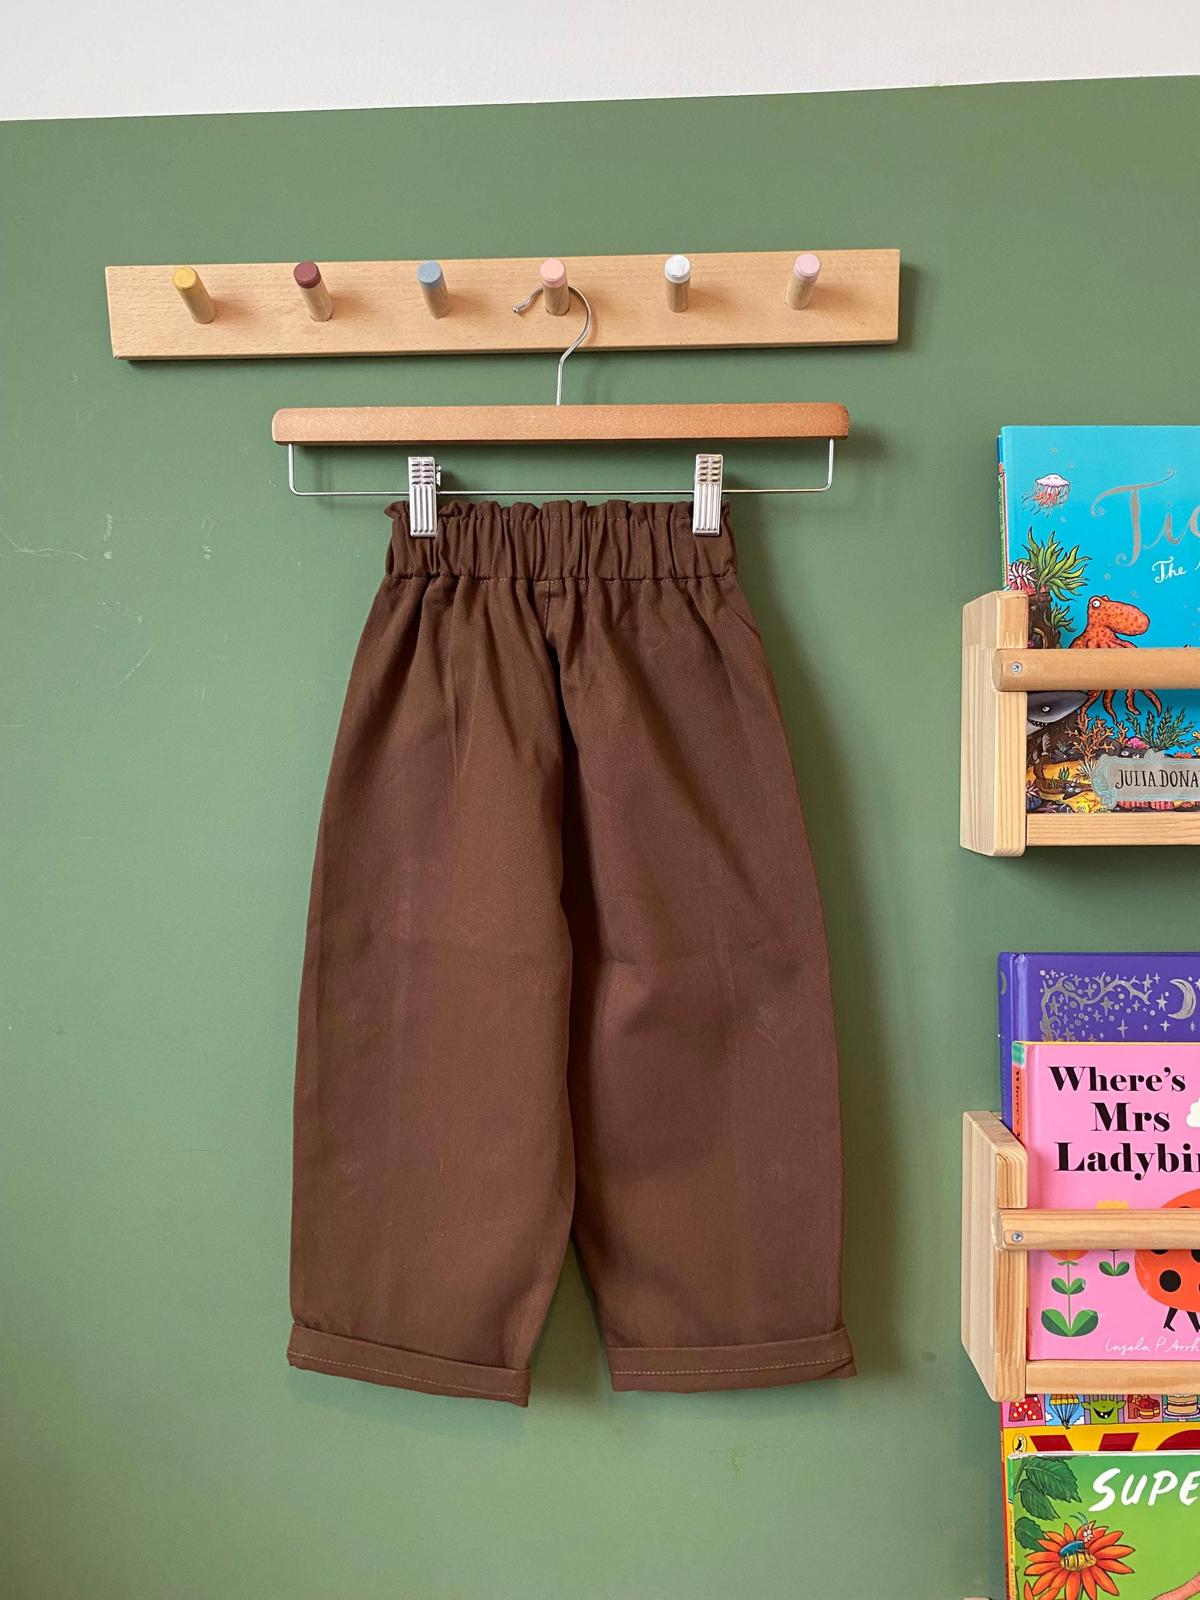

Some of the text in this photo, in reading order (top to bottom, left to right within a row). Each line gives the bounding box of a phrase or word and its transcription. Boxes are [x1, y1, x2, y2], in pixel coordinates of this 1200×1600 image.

[1152, 556, 1187, 584] The
[1115, 769, 1200, 790] JULIA DONA
[1048, 1066, 1186, 1092] Where’s
[1090, 1102, 1172, 1132] Mrs
[1054, 1142, 1200, 1181] Ladybi
[1155, 1335, 1167, 1352] P
[1088, 1468, 1200, 1512] SUPE
